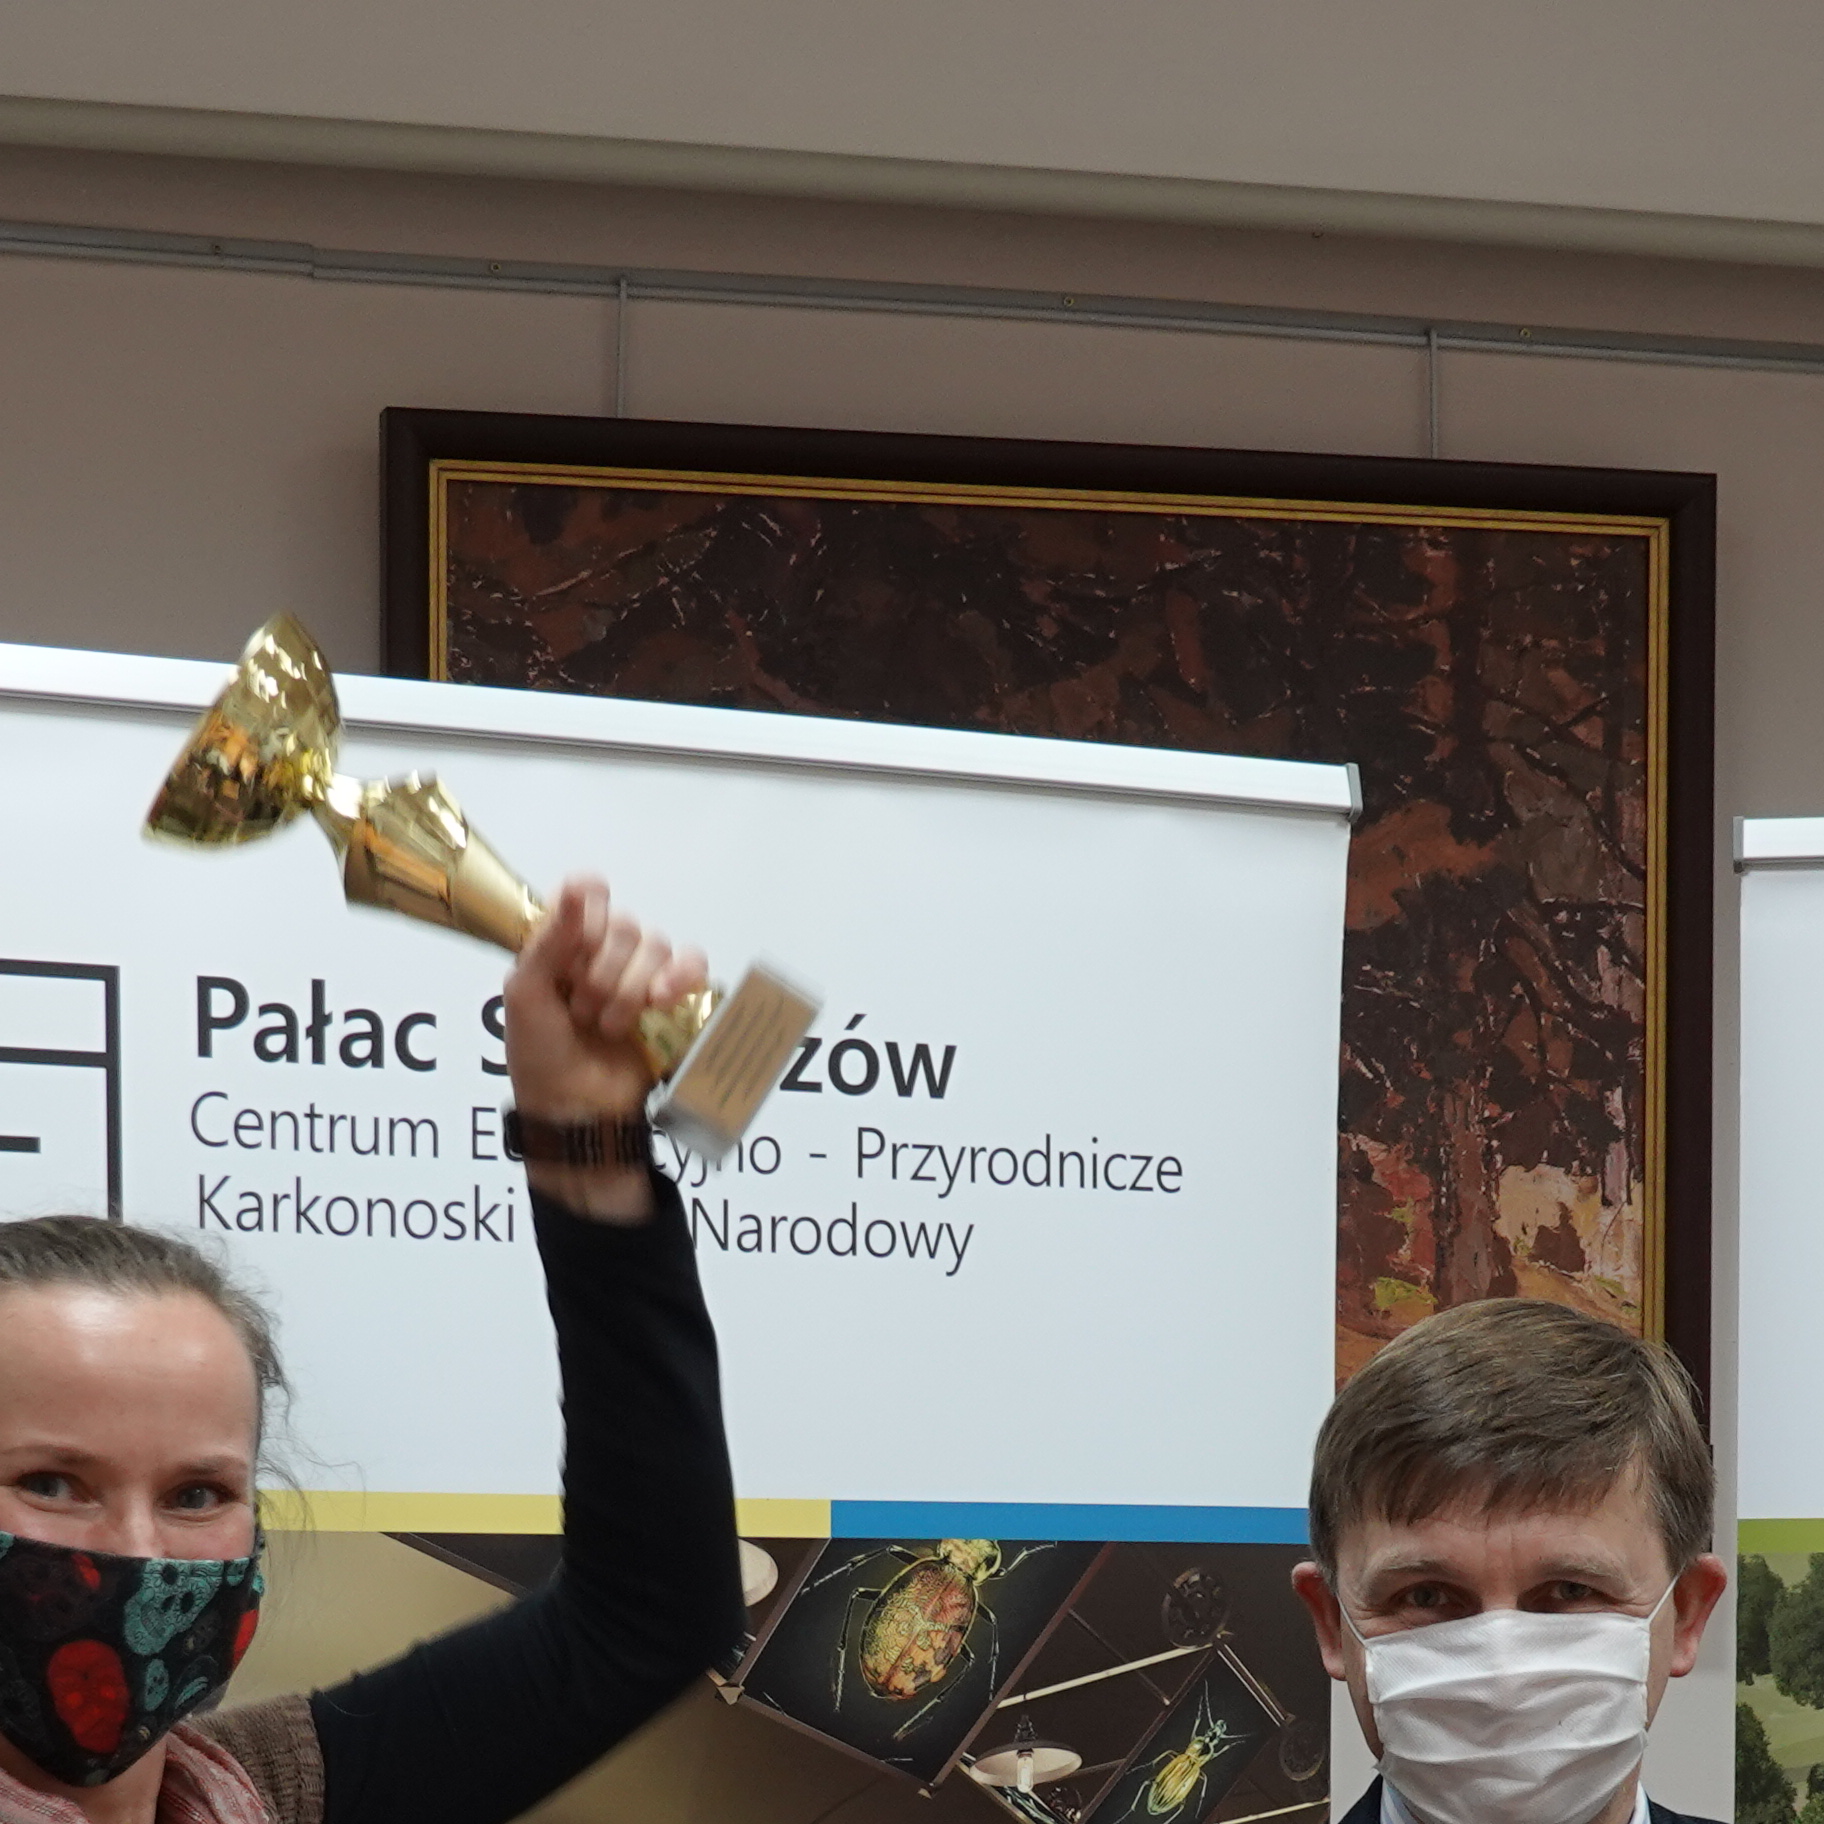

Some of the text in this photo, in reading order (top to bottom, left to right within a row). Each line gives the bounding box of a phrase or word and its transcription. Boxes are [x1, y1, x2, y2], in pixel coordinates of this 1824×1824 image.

[196, 975, 437, 1072] Pałac
[191, 1091, 439, 1158] Centrum
[857, 1127, 1183, 1199] Przyrodnicze
[199, 1174, 974, 1277] Karkonoski Narodowy
